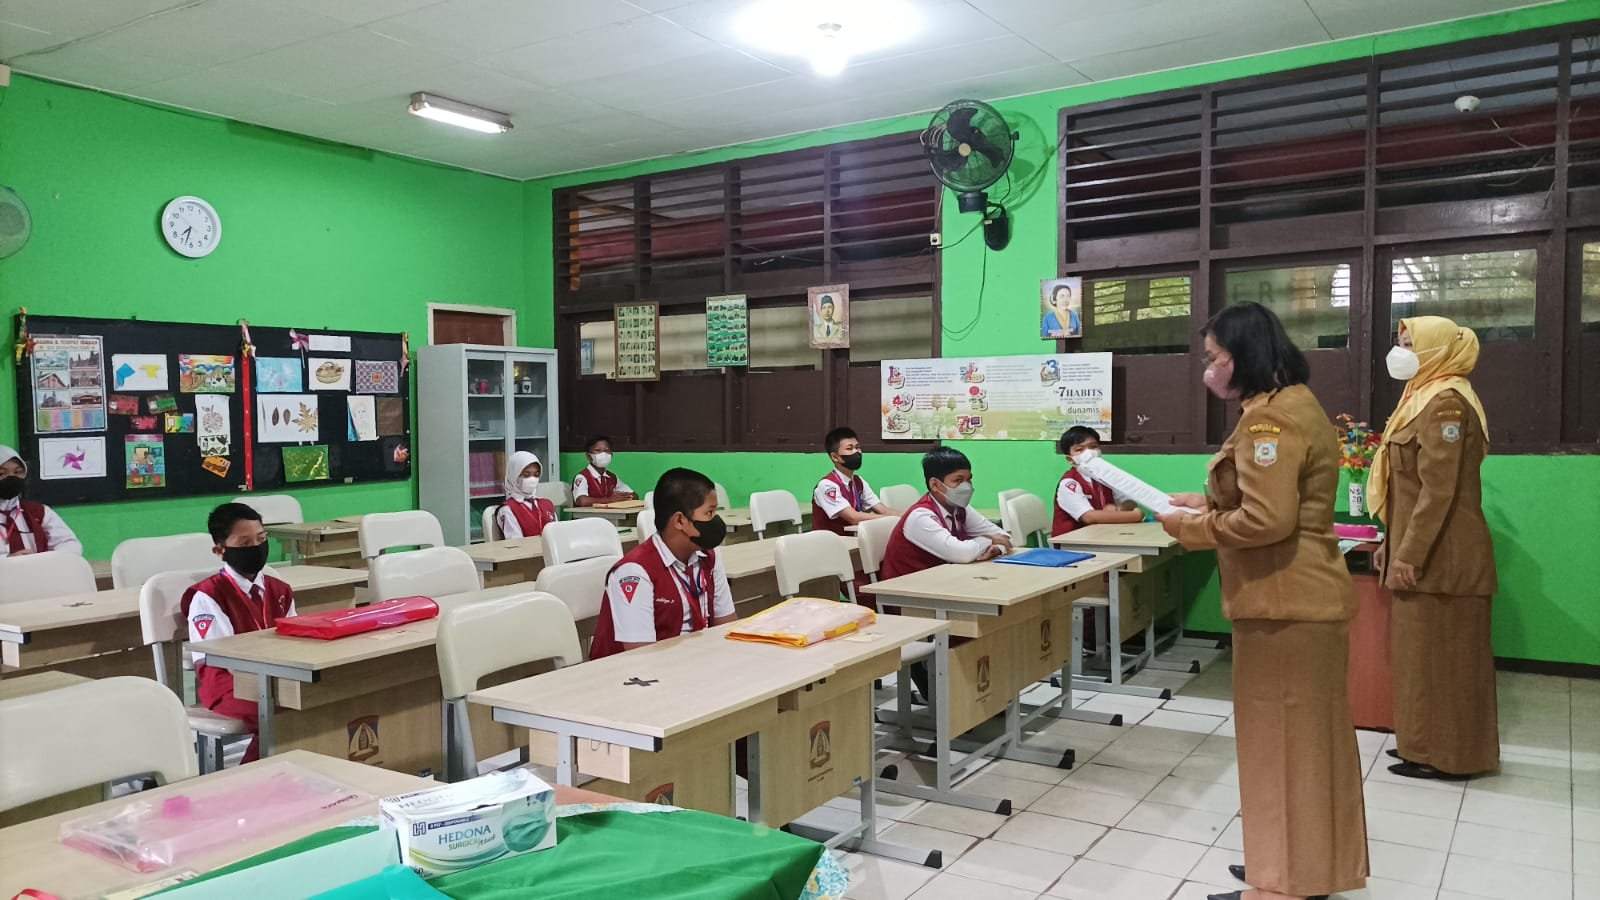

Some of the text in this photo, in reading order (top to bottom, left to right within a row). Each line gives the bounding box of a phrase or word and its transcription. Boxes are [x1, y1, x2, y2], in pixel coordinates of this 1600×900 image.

[1066, 388, 1104, 398] HABITS
[1067, 405, 1101, 414] dunamis
[438, 825, 491, 844] HEDONA
